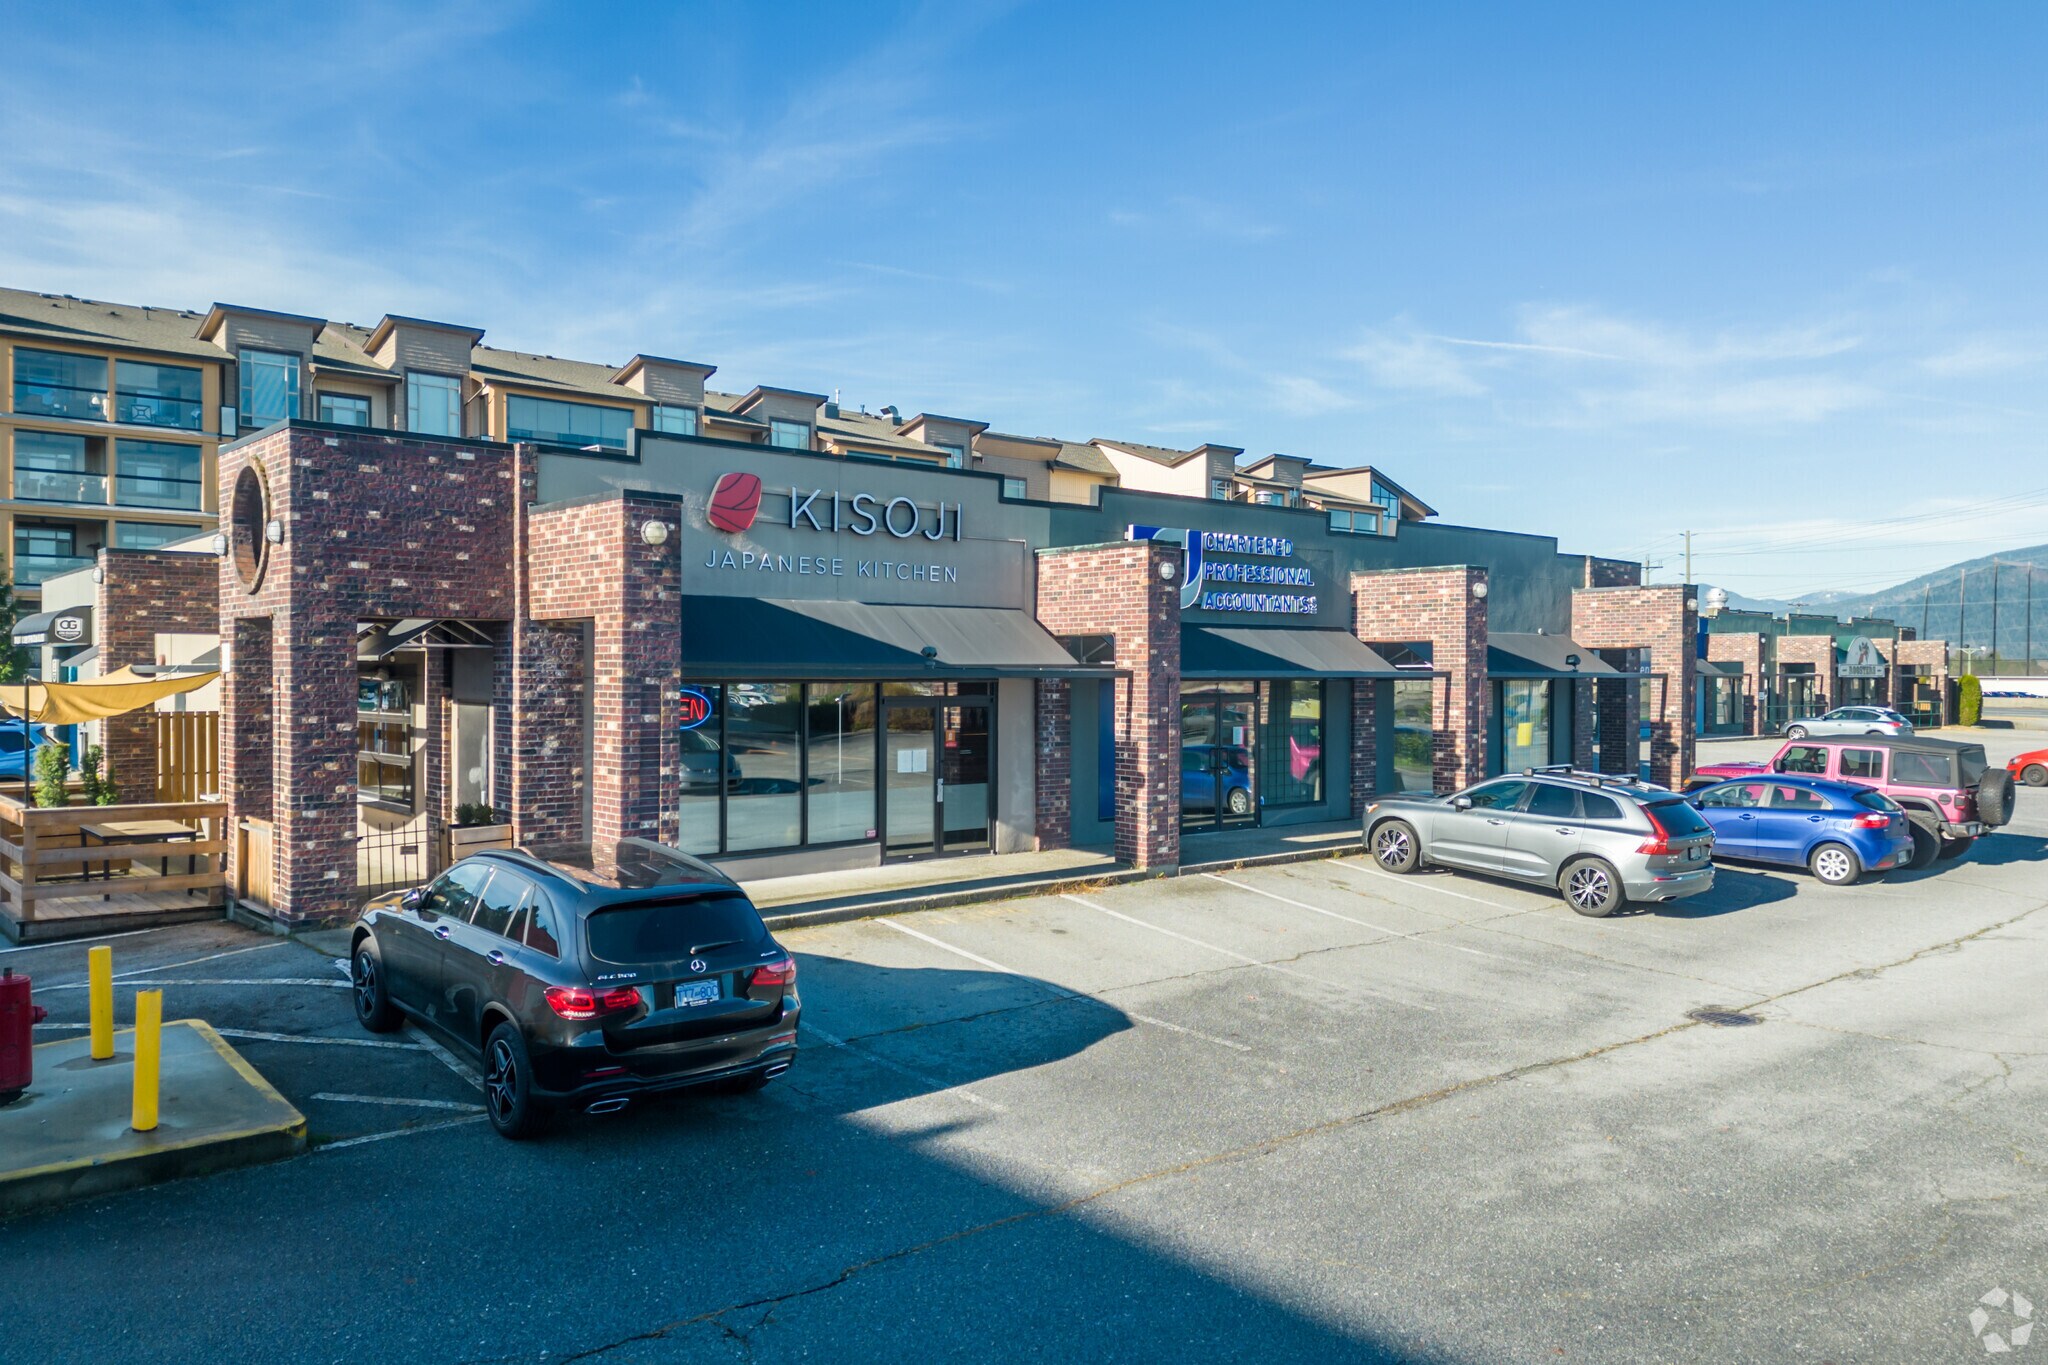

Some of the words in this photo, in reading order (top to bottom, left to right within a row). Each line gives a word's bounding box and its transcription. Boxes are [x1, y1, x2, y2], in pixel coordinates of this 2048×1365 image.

[788, 486, 963, 542] KISOJI
[1203, 532, 1294, 557] CHARTERED
[705, 550, 844, 576] JAPANESE
[858, 560, 958, 583] KITCHEN
[1203, 562, 1315, 587] PROFESSIONAL
[1201, 591, 1309, 614] ACCOUNTANTS
[679, 698, 704, 720] EN
